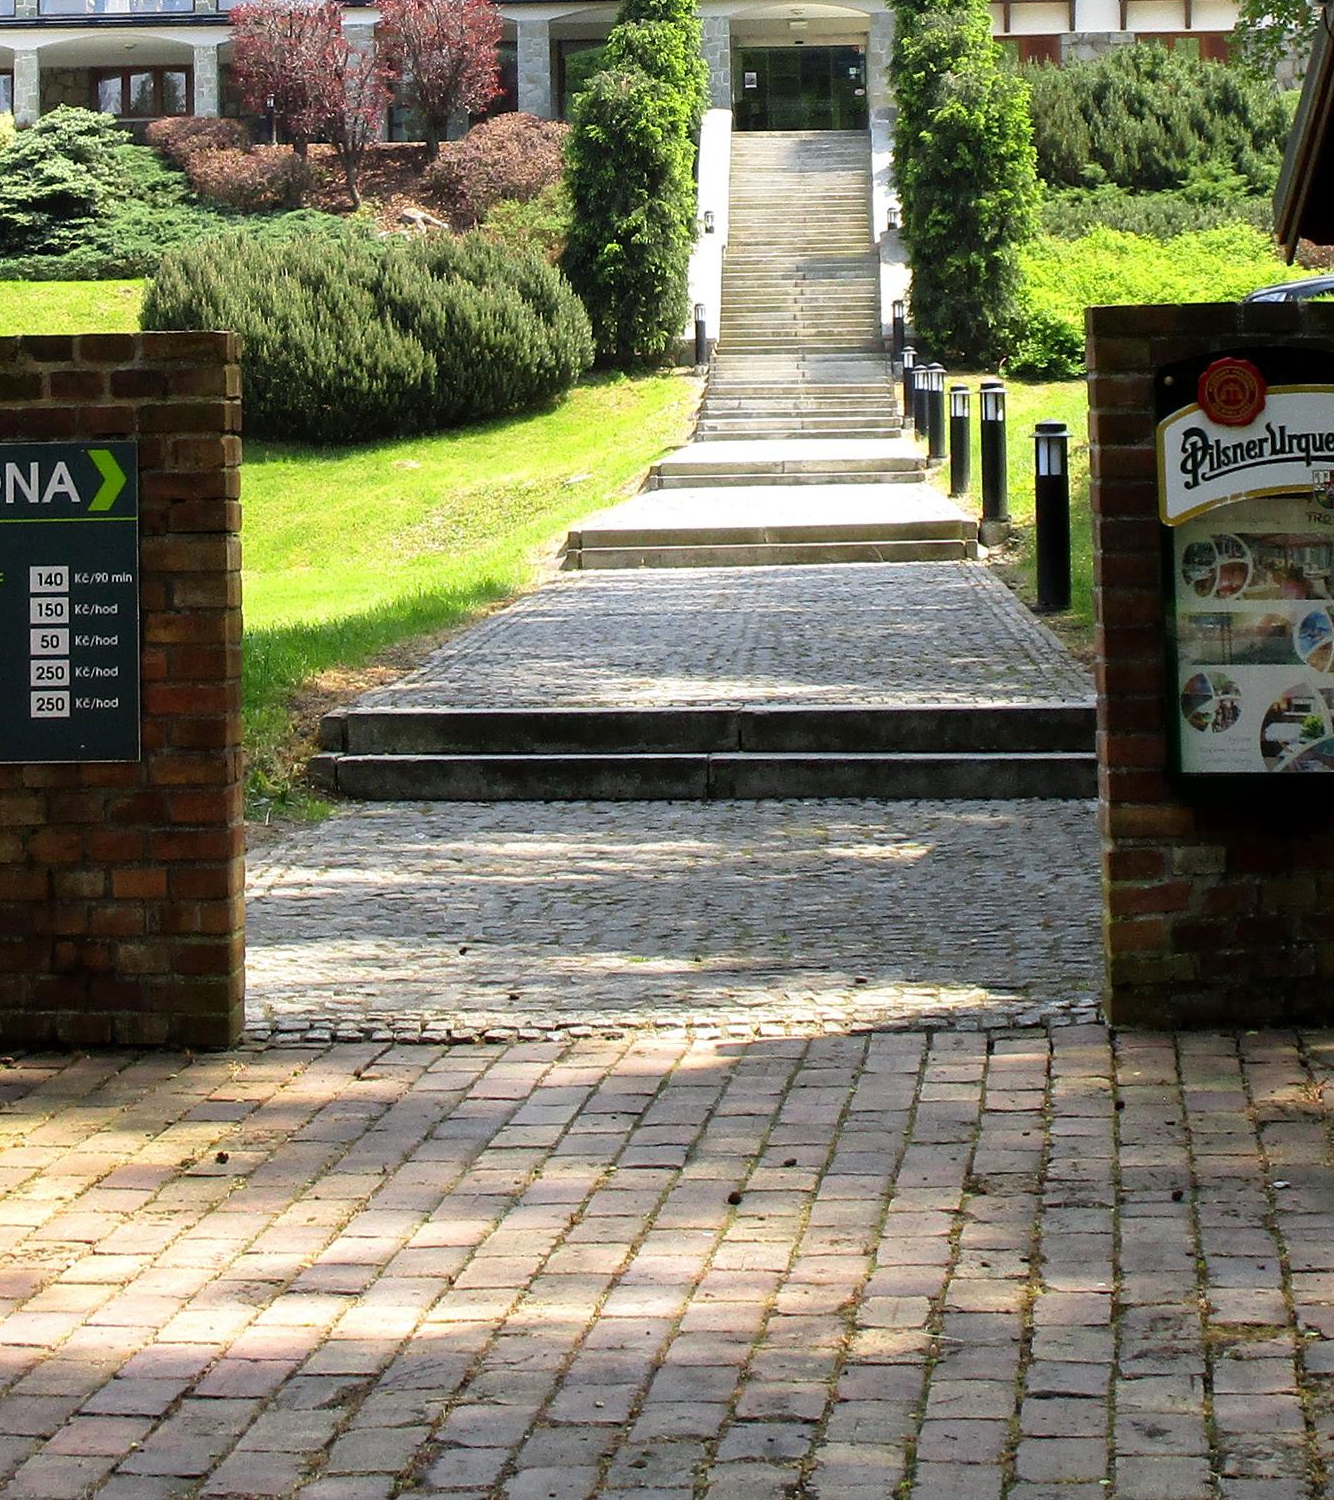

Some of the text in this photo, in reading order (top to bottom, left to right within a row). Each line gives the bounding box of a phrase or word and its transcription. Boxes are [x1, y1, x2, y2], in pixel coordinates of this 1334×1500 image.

[1180, 427, 1268, 490] Pilsner
[37, 572, 64, 587] 140
[74, 572, 109, 584] Kč/90
[111, 572, 133, 583] min
[37, 603, 64, 617] 150
[74, 604, 118, 615] Kč/hod
[40, 635, 60, 649] 50
[74, 635, 119, 646] Kč/hod
[35, 666, 65, 680] 250
[75, 666, 119, 678] Kč/hod
[36, 697, 65, 712] 250
[75, 697, 119, 709] Kč/hod
